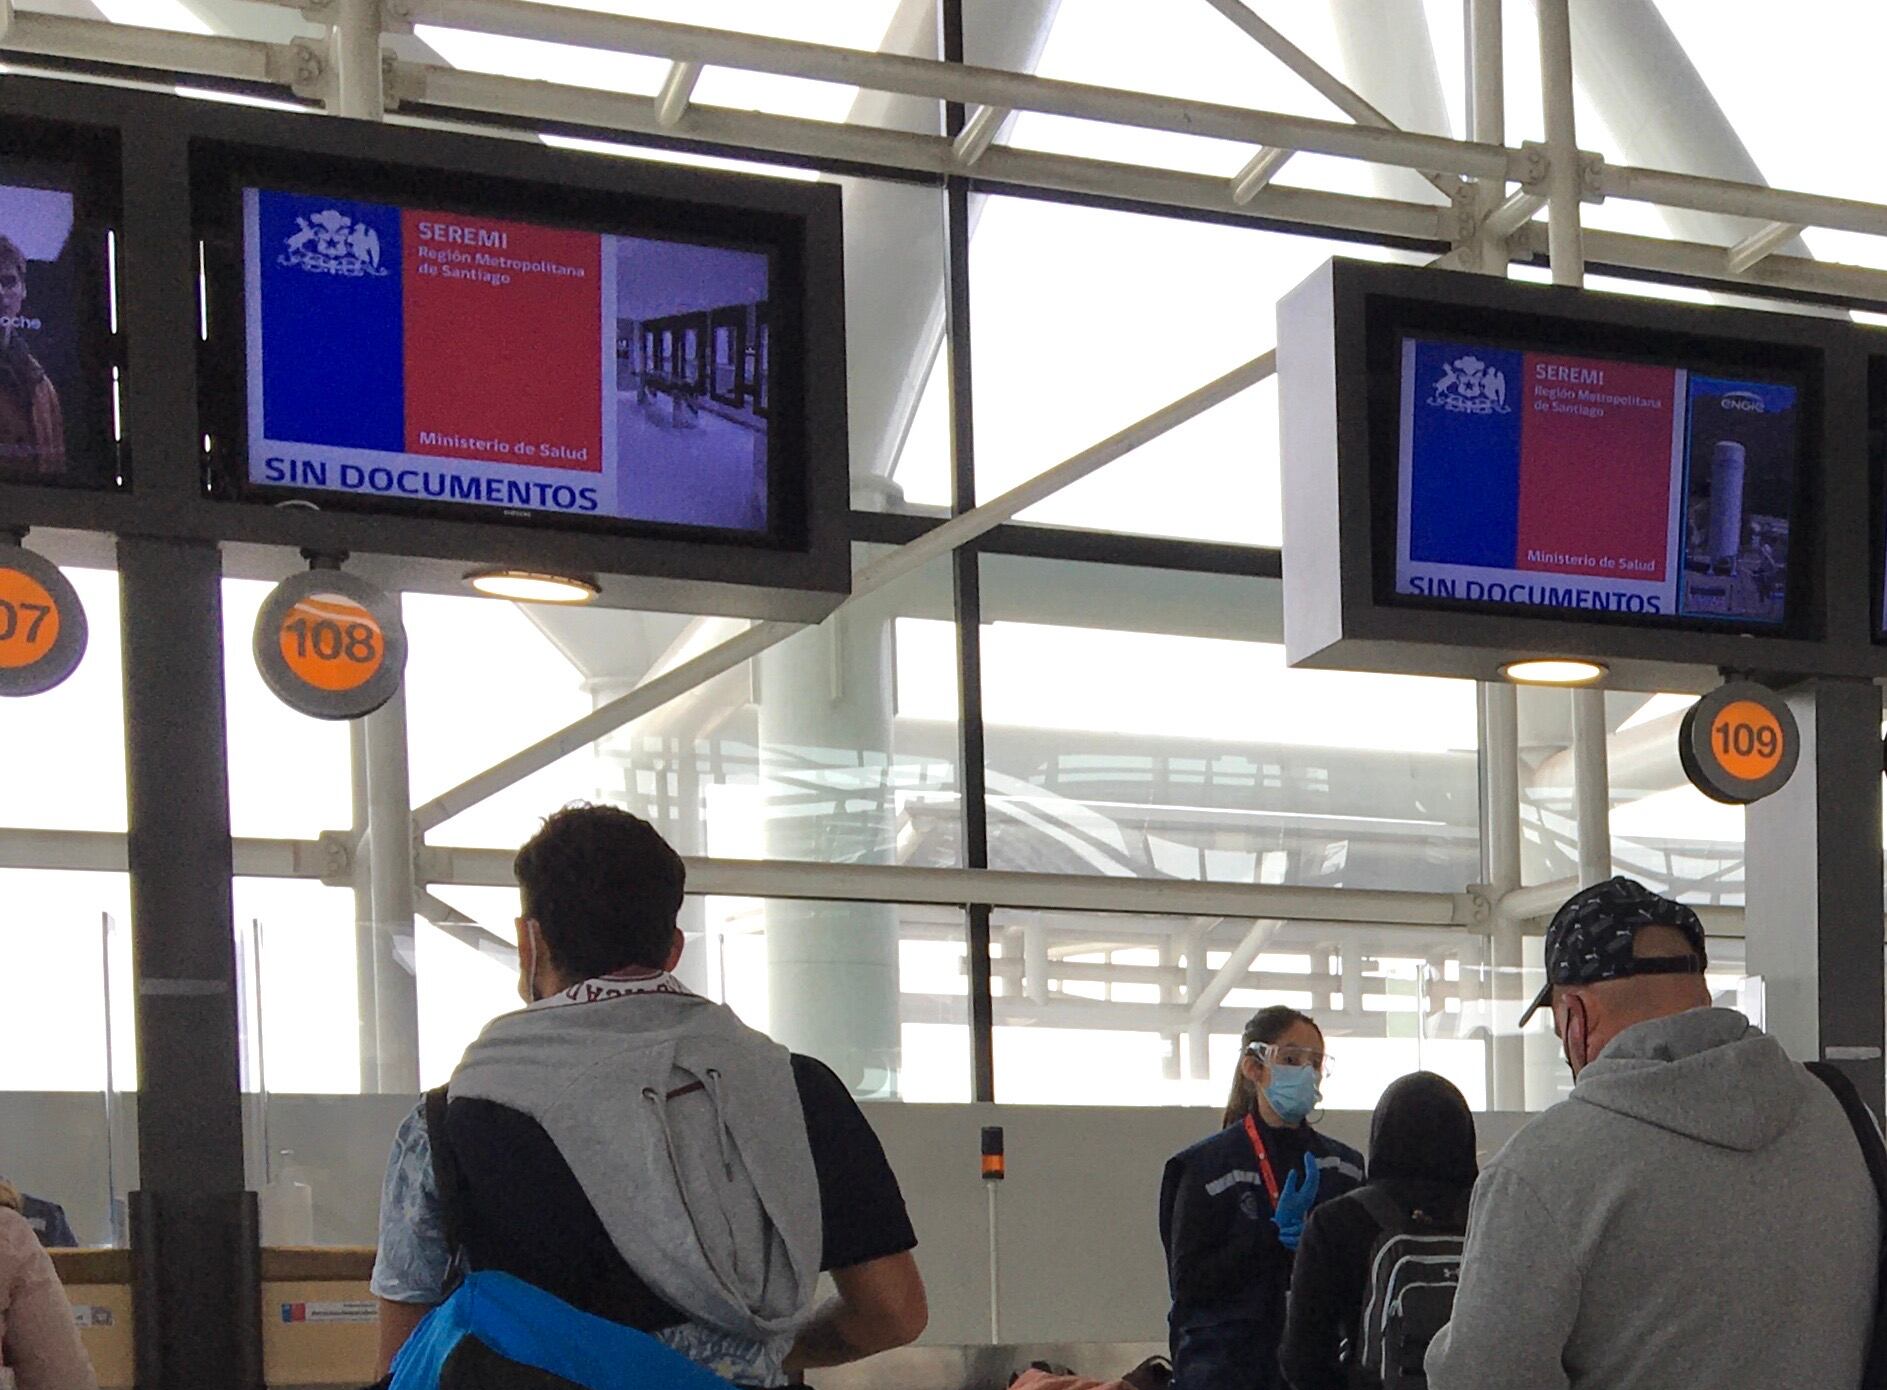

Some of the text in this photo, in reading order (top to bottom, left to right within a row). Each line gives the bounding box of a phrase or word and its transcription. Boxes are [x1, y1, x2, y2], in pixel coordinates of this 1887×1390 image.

[418, 221, 508, 249] SEREMI
[418, 262, 511, 285] de Santiago
[475, 252, 585, 279] Metropolitana
[1534, 363, 1604, 386] SEREMI
[1534, 400, 1604, 418] de Santiago
[420, 431, 587, 461] Ministerio de Salud
[265, 456, 599, 512] SIN DOCUMENTOS
[1527, 549, 1656, 572] Ministerio de Salud
[1408, 576, 1662, 615] SIN DOCUMENTOS
[286, 618, 377, 664] 108
[1715, 722, 1777, 758] 109
